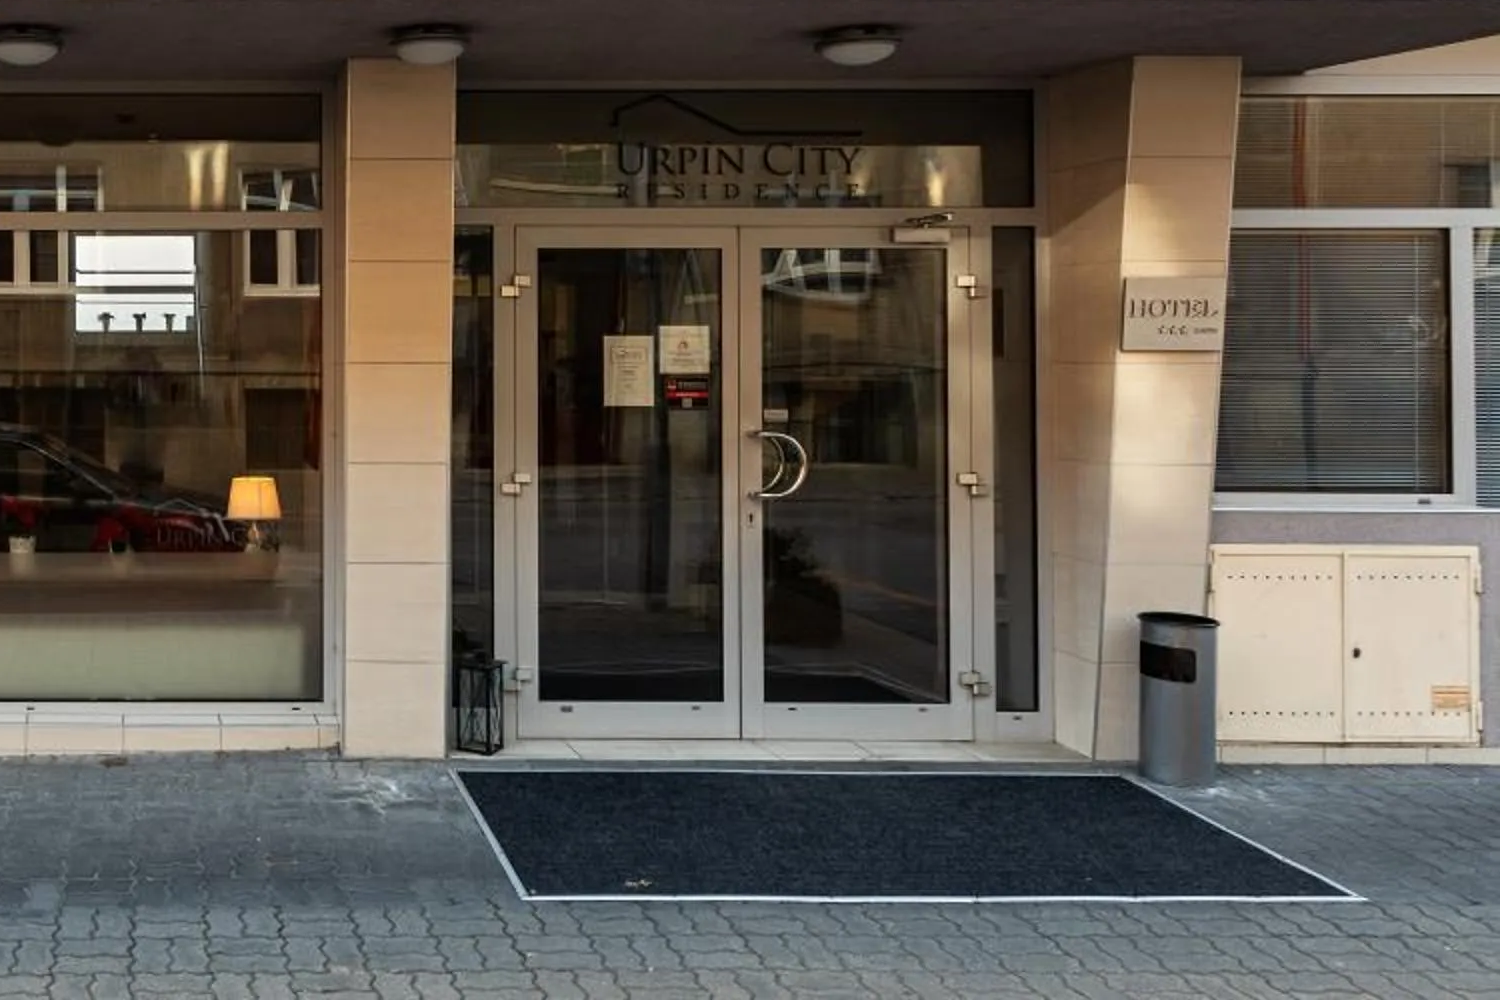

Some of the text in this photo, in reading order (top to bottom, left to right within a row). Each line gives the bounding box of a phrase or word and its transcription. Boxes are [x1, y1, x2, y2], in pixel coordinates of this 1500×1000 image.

[763, 141, 862, 176] CITY
[616, 183, 862, 200] RESIDENCE
[1129, 298, 1219, 319] HOTEL
